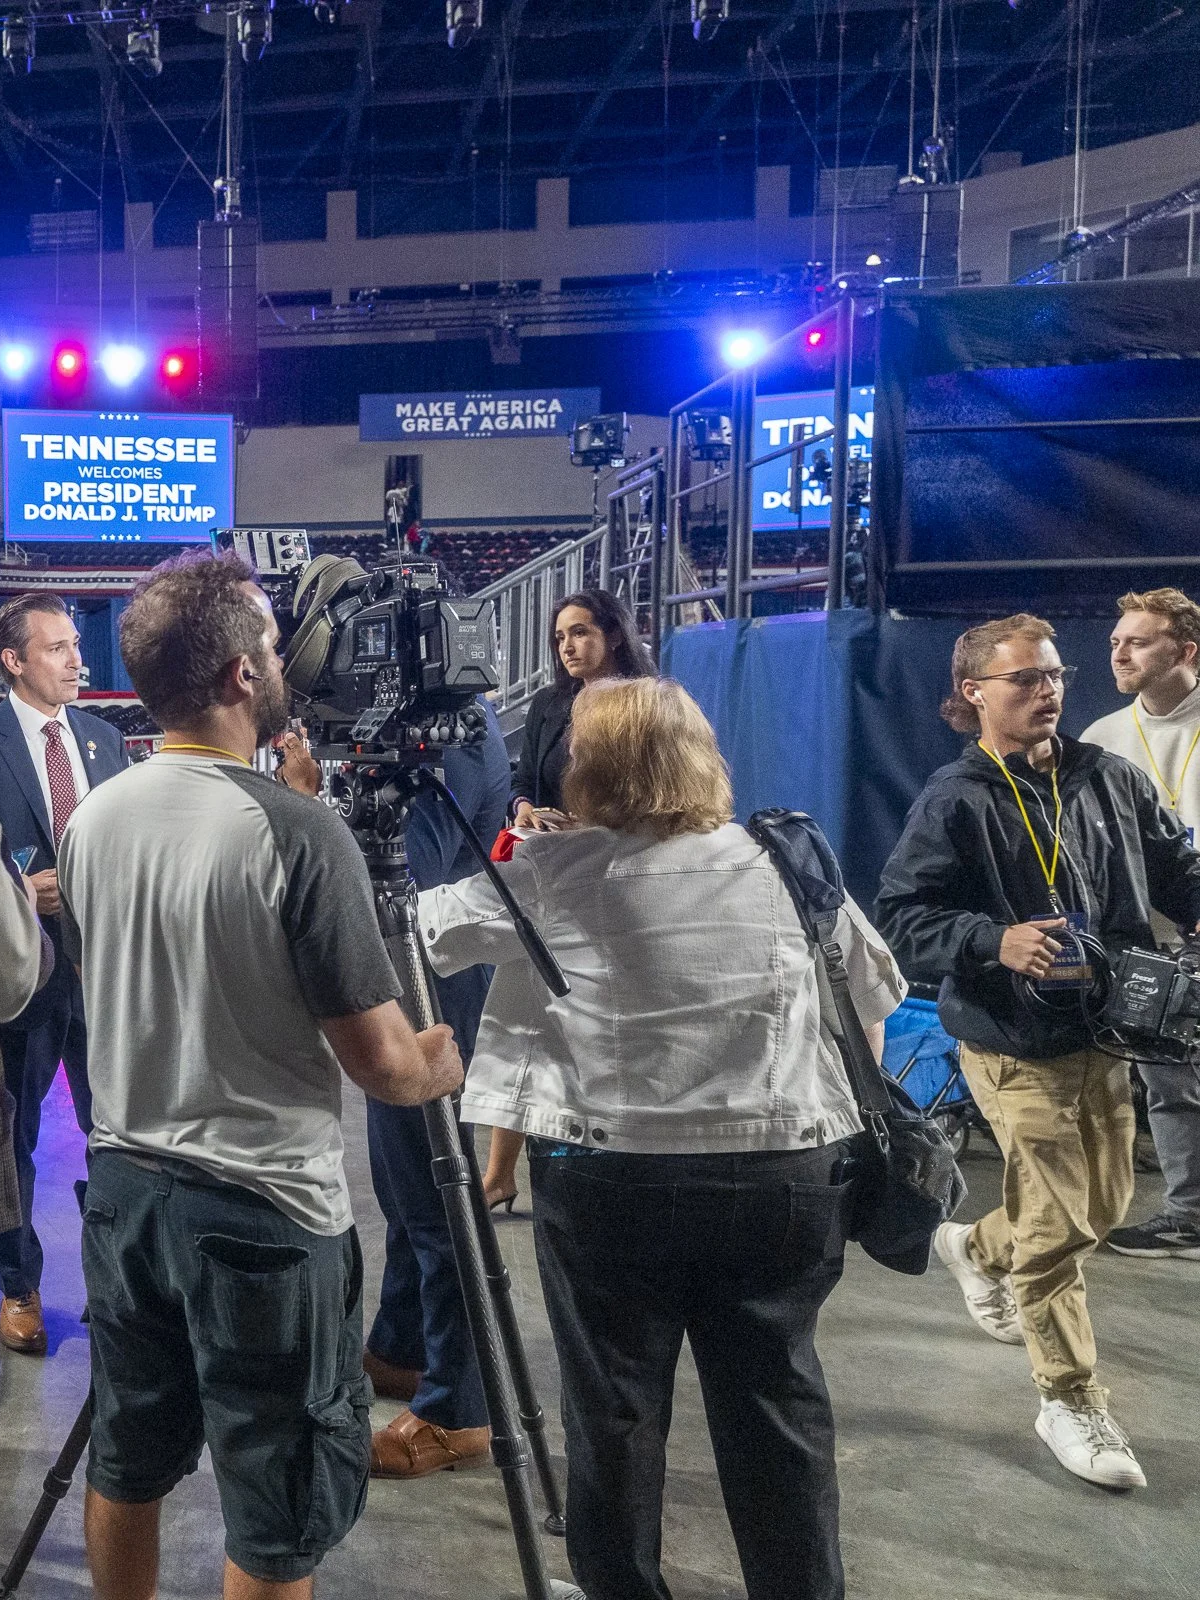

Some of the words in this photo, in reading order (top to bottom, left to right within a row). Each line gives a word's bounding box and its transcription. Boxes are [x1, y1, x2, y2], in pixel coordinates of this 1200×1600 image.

[396, 401, 456, 418] MAKE
[463, 398, 563, 416] AMERICA
[401, 416, 472, 432] GREAT
[479, 413, 557, 431] AGAIN!
[20, 433, 217, 463] TENNESSEE
[78, 465, 163, 480] WELCOMES
[43, 481, 197, 504] PRESIDENT
[24, 503, 116, 521] DONALD
[121, 505, 138, 522] J.
[143, 505, 216, 523] TRUMP
[471, 651, 485, 659] 90
